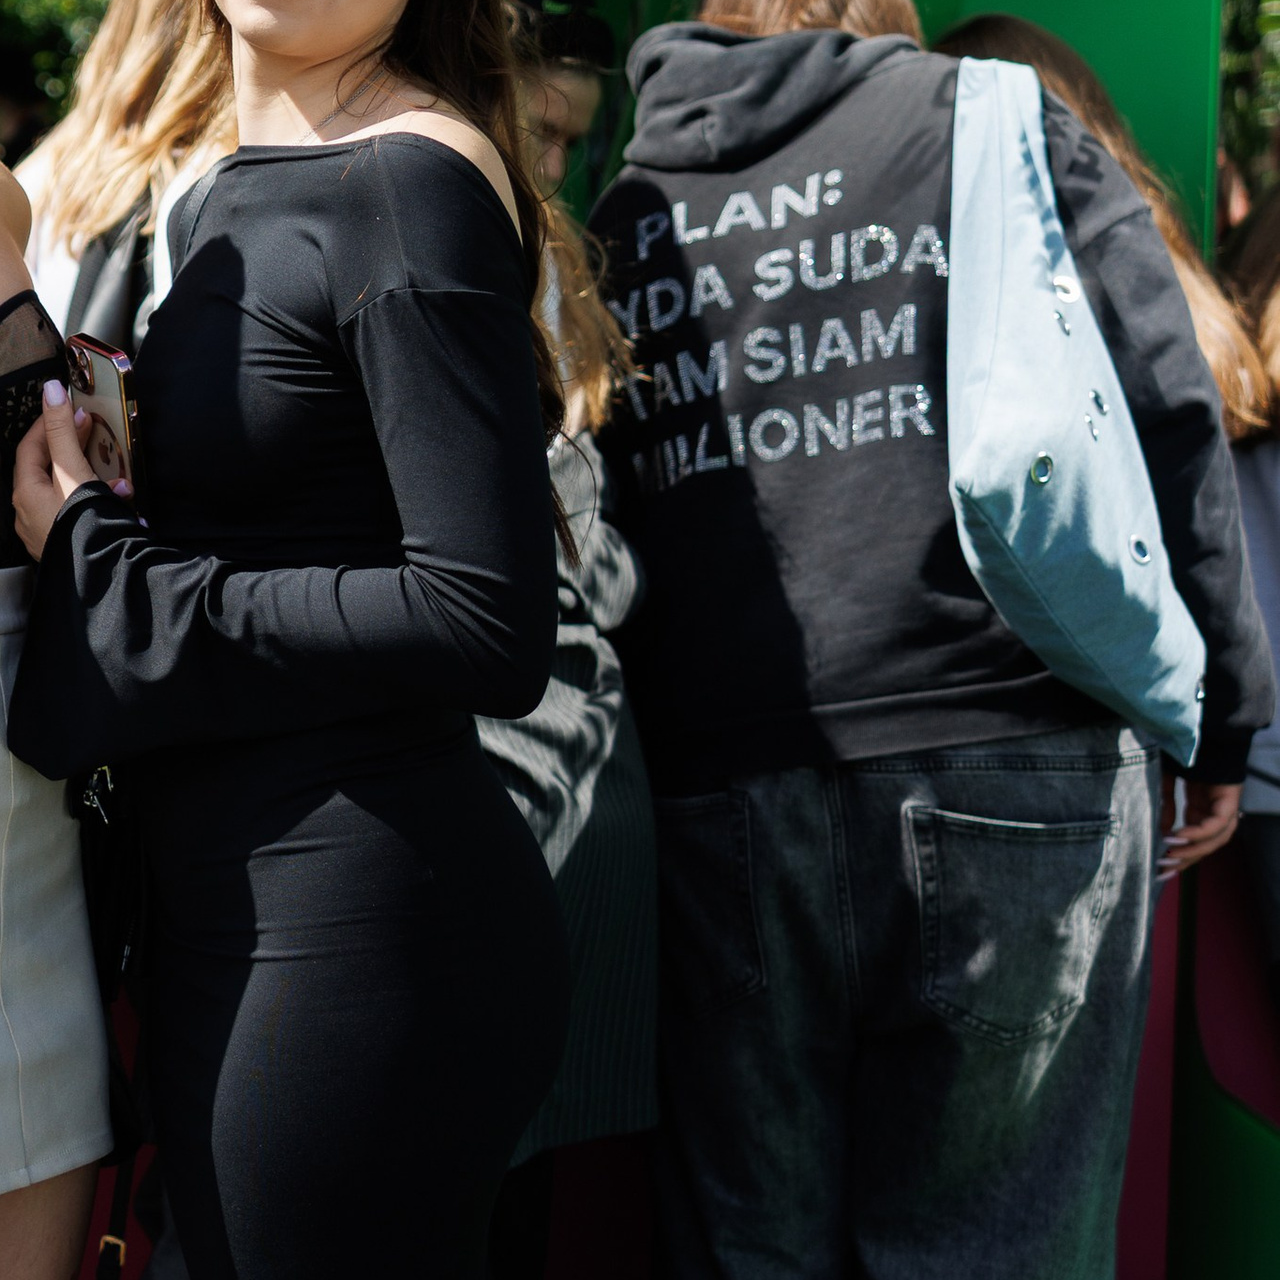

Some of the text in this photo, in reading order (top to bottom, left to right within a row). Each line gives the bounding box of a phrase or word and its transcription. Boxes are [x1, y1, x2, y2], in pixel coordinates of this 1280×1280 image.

[634, 168, 844, 263] PLAN:
[751, 223, 950, 302] SUDA
[741, 302, 917, 385] SIAM
